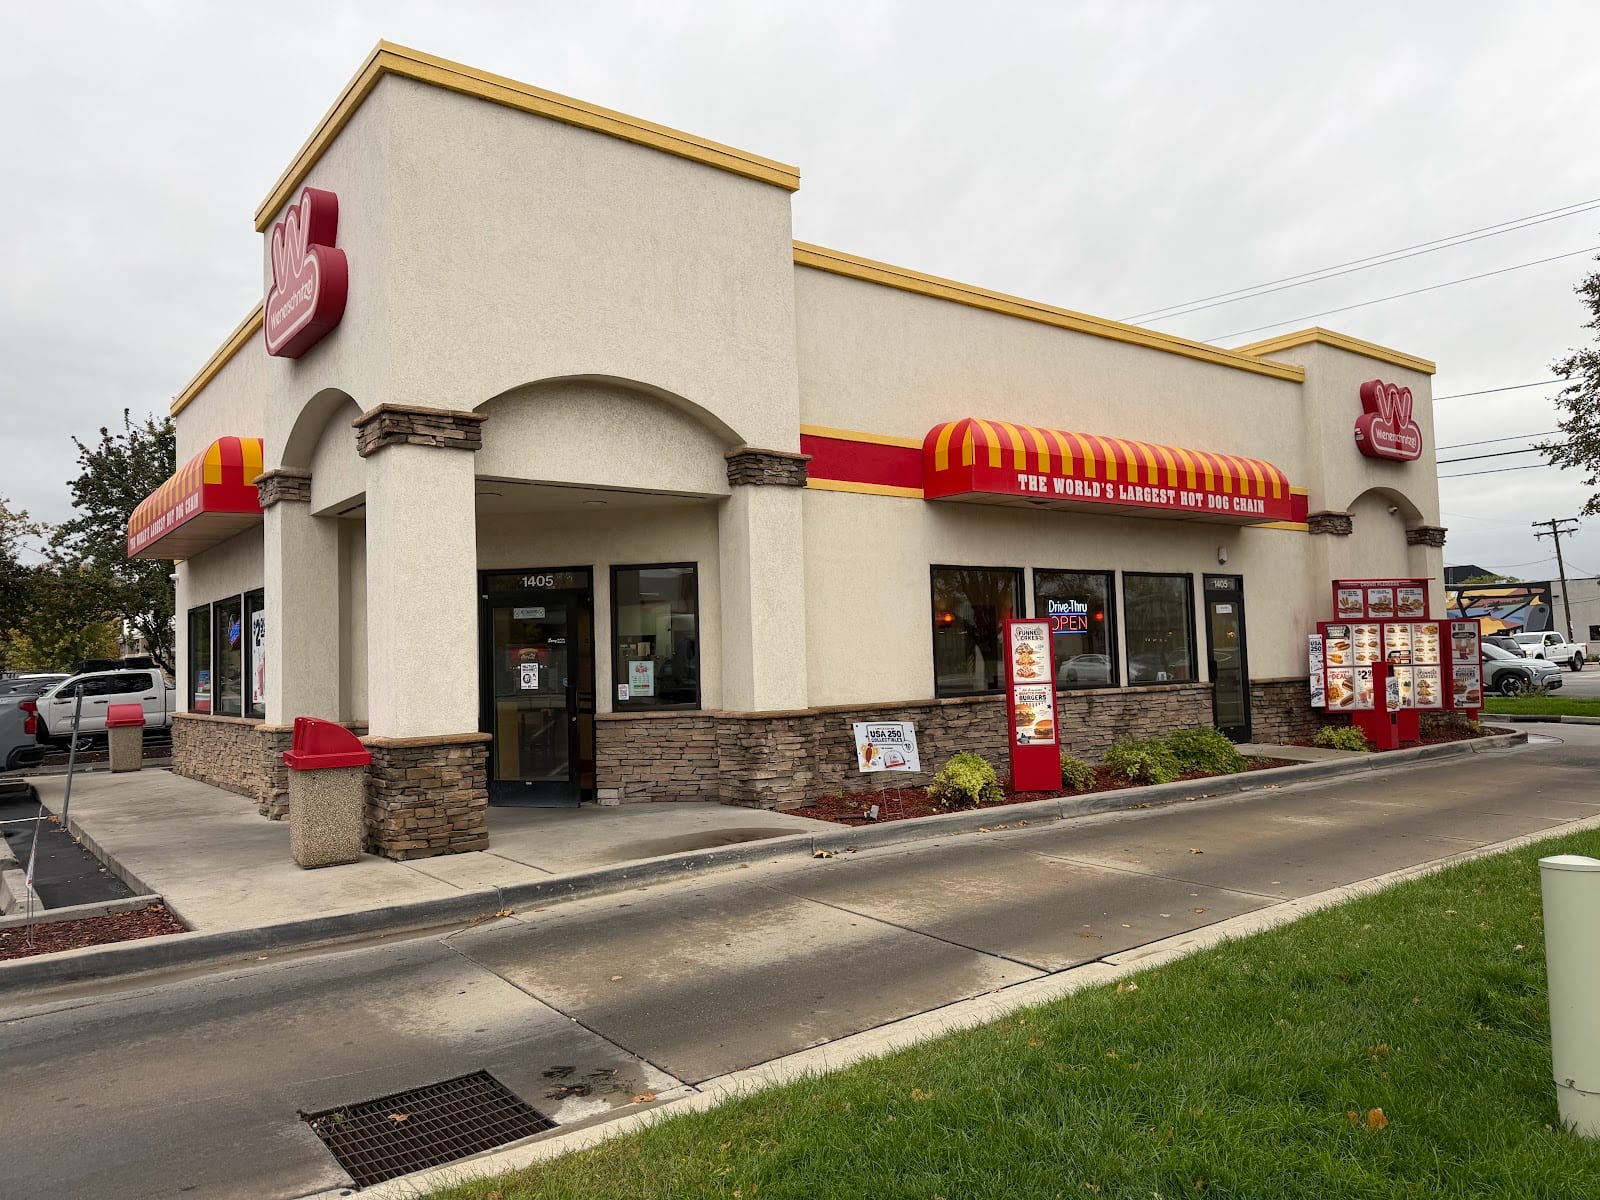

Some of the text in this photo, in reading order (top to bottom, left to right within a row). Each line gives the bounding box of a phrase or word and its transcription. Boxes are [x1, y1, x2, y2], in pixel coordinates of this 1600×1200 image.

[271, 274, 313, 330] Wienerschnitzel
[1375, 428, 1417, 449] Wienerschnitzel
[1017, 473, 1265, 514] THE WORLD'S LARGEST HOT DOG CHAIN
[521, 575, 554, 588] 1405
[1213, 579, 1229, 589] 1405
[1048, 599, 1088, 613] Drive-Thru
[1051, 615, 1088, 631] OPEN
[869, 730, 902, 738] USA 250
